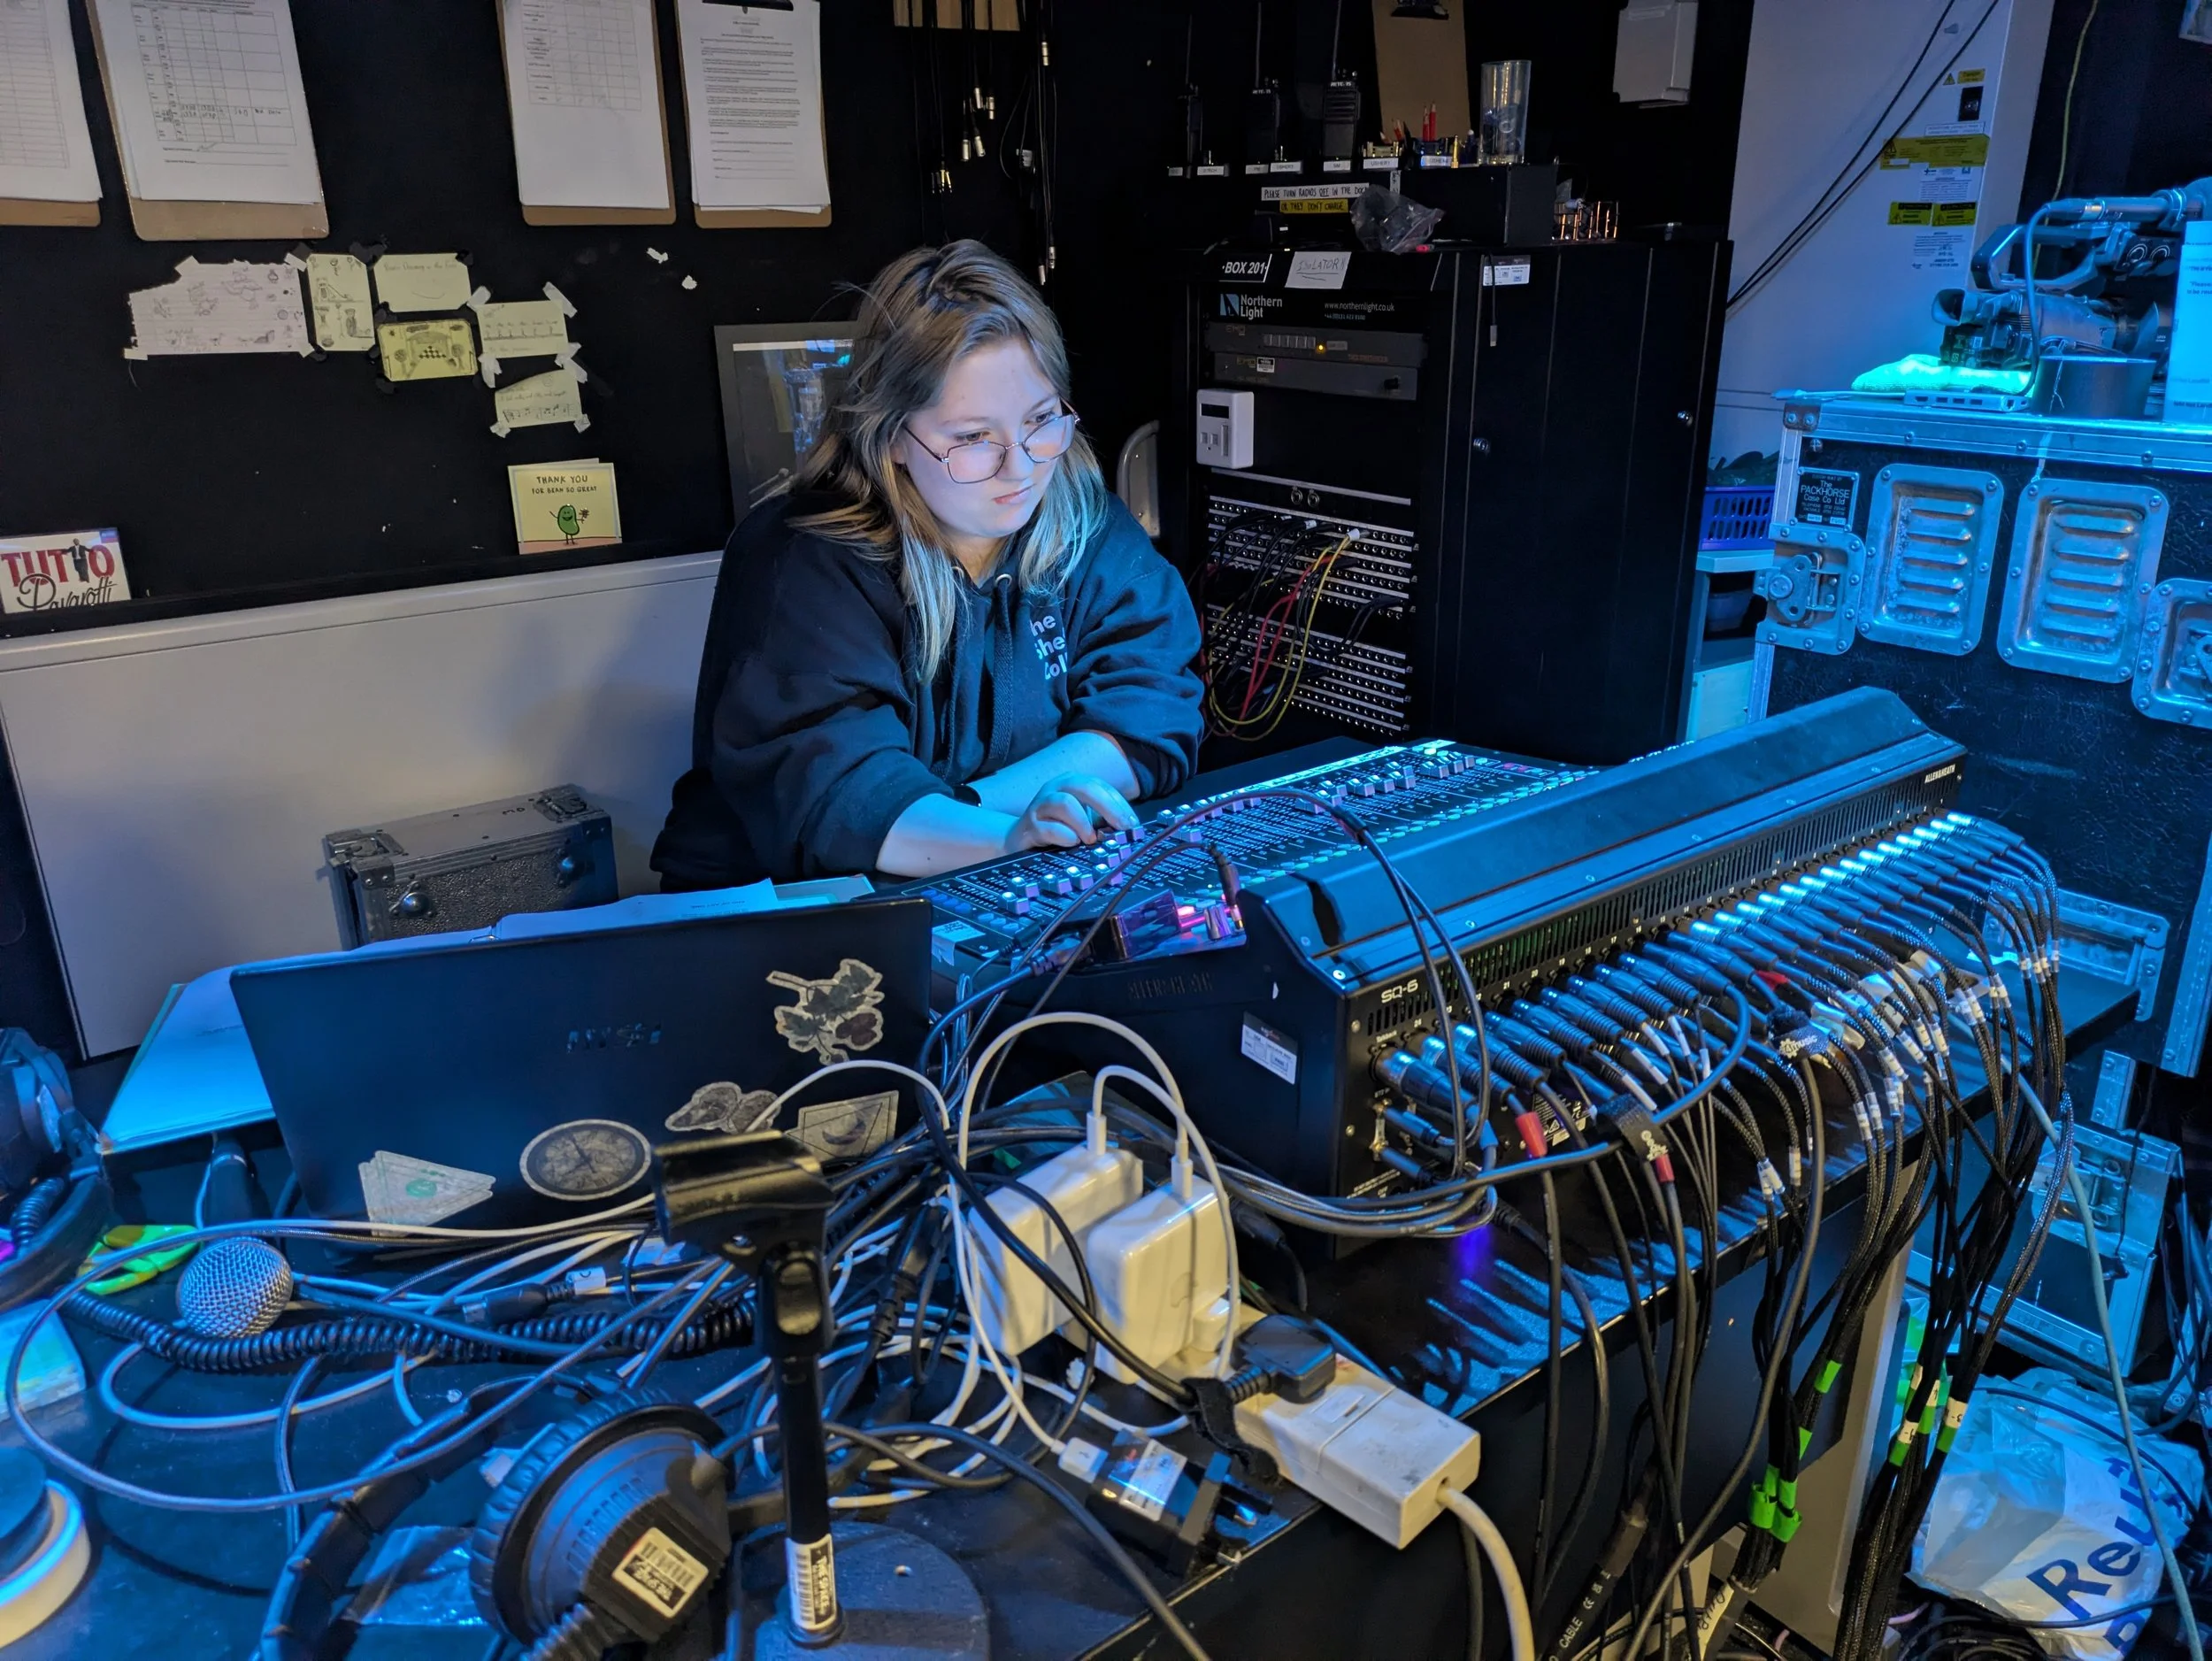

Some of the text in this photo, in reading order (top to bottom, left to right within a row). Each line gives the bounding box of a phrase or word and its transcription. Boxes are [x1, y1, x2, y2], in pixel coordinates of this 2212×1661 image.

[1263, 188, 1280, 200] PLEASE
[1283, 188, 1296, 198] TURN
[1298, 186, 1317, 197] RADIOS
[1318, 185, 1330, 196] OFF
[1341, 183, 1352, 195] THE
[1290, 201, 1303, 211] THEY
[1325, 201, 1344, 211] CHARGE
[1224, 260, 1266, 274] BOX 201
[1240, 294, 1283, 308] Northern
[1324, 302, 1395, 313] www.northernlight.co.uk
[1240, 306, 1263, 320] Light
[536, 474, 588, 484] THANK YOU
[1820, 480, 1833, 488] The
[1800, 484, 1851, 499] PACKHORSE
[1803, 493, 1820, 503] Case
[0, 544, 115, 588] TUTTO
[1380, 979, 1419, 1004] SQ-6
[1558, 1616, 1584, 1649] CABLE
